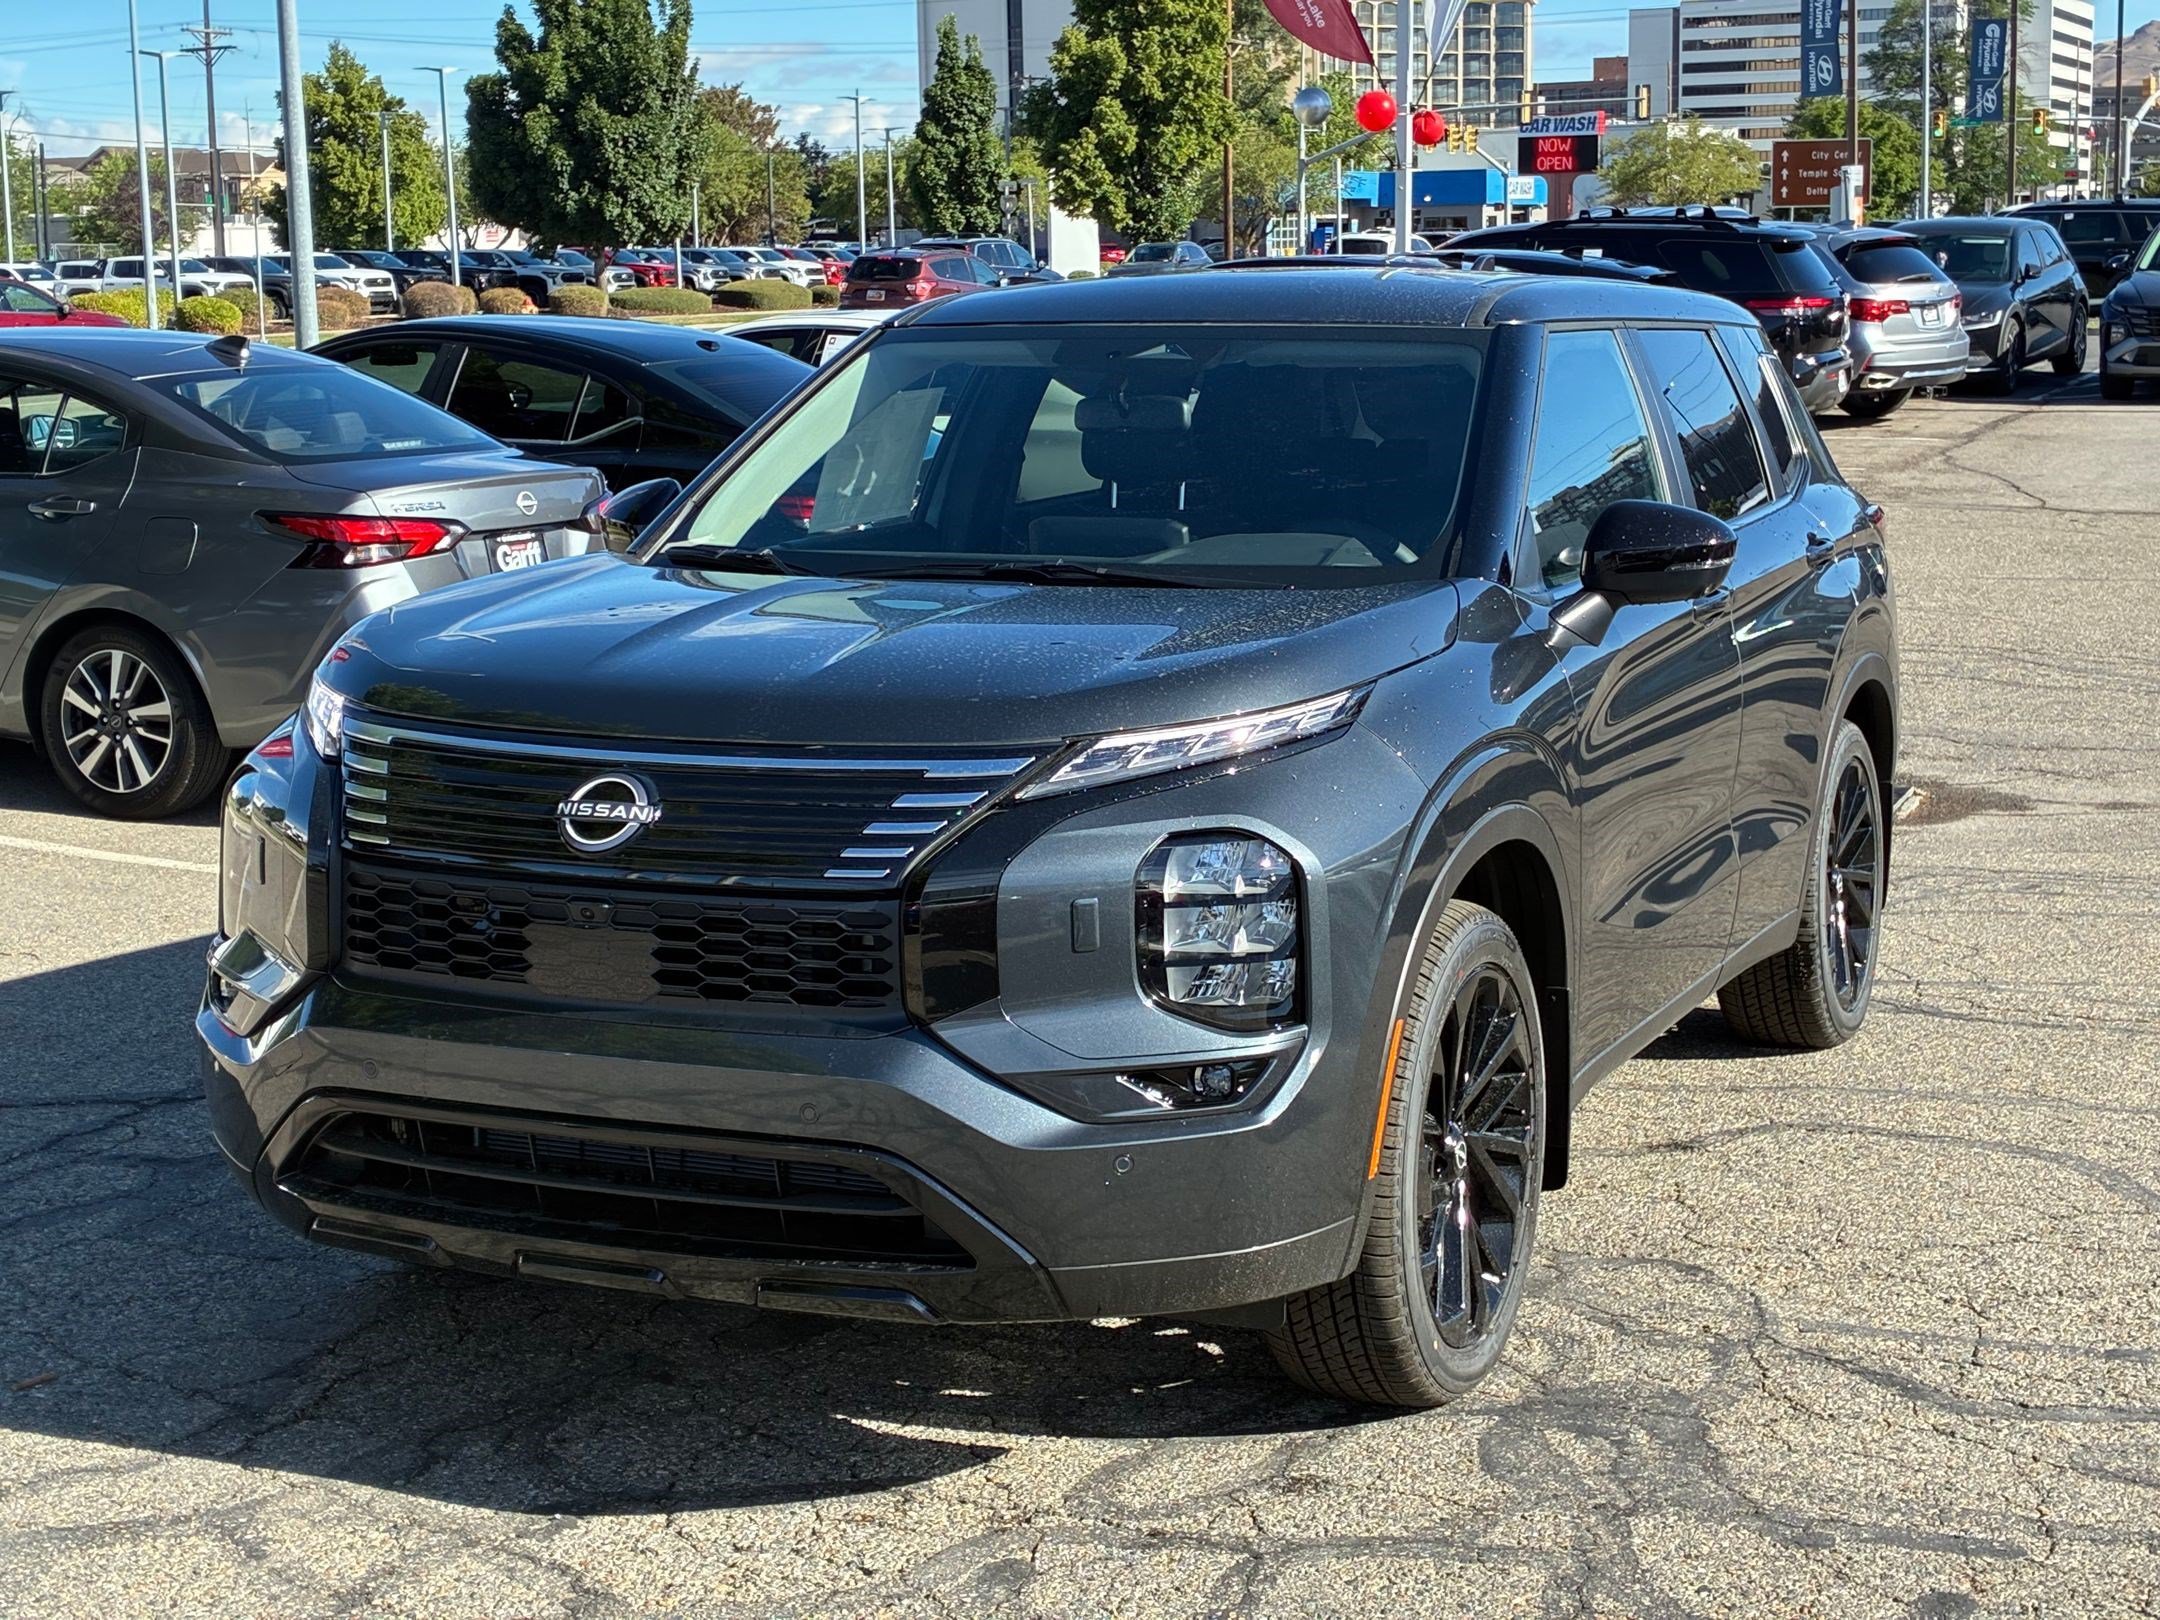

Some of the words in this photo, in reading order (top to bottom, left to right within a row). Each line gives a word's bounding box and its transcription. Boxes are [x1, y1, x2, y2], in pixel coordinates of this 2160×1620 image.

[1300, 11, 1313, 27] you
[1983, 38, 1993, 75] Hyundai
[1520, 118, 1550, 134] CAR
[1553, 116, 1597, 132] WASH
[1538, 138, 1571, 152] NOW
[1536, 156, 1572, 170] OPEN
[1811, 151, 1829, 160] City
[1798, 169, 1828, 178] Temple
[1806, 187, 1828, 196] Delta
[497, 541, 541, 572] Garff
[557, 802, 649, 823] NISSAN
